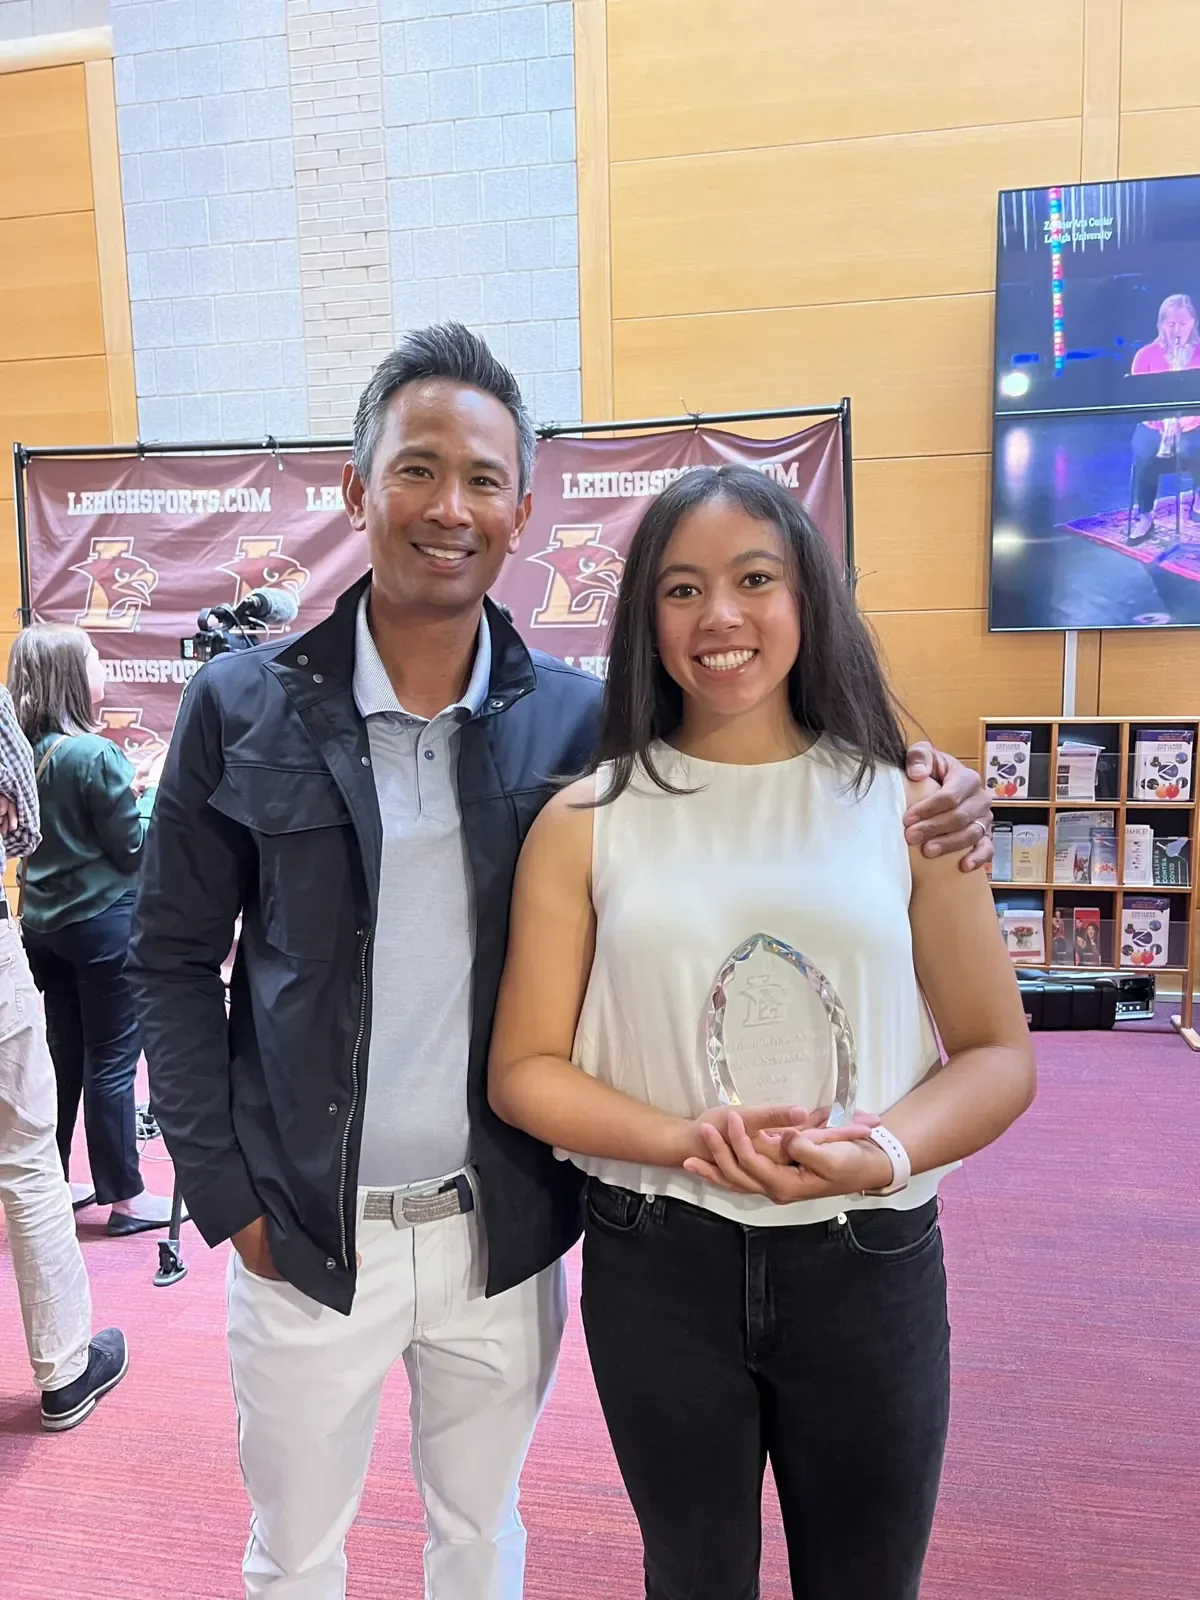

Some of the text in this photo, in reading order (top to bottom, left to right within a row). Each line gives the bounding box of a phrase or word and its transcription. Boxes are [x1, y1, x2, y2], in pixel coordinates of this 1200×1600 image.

[1088, 216, 1114, 227] Center
[1072, 230, 1113, 241] University
[67, 487, 272, 515] LEHIGHSPORTS.COM
[100, 659, 205, 684] HIGHSPOR
